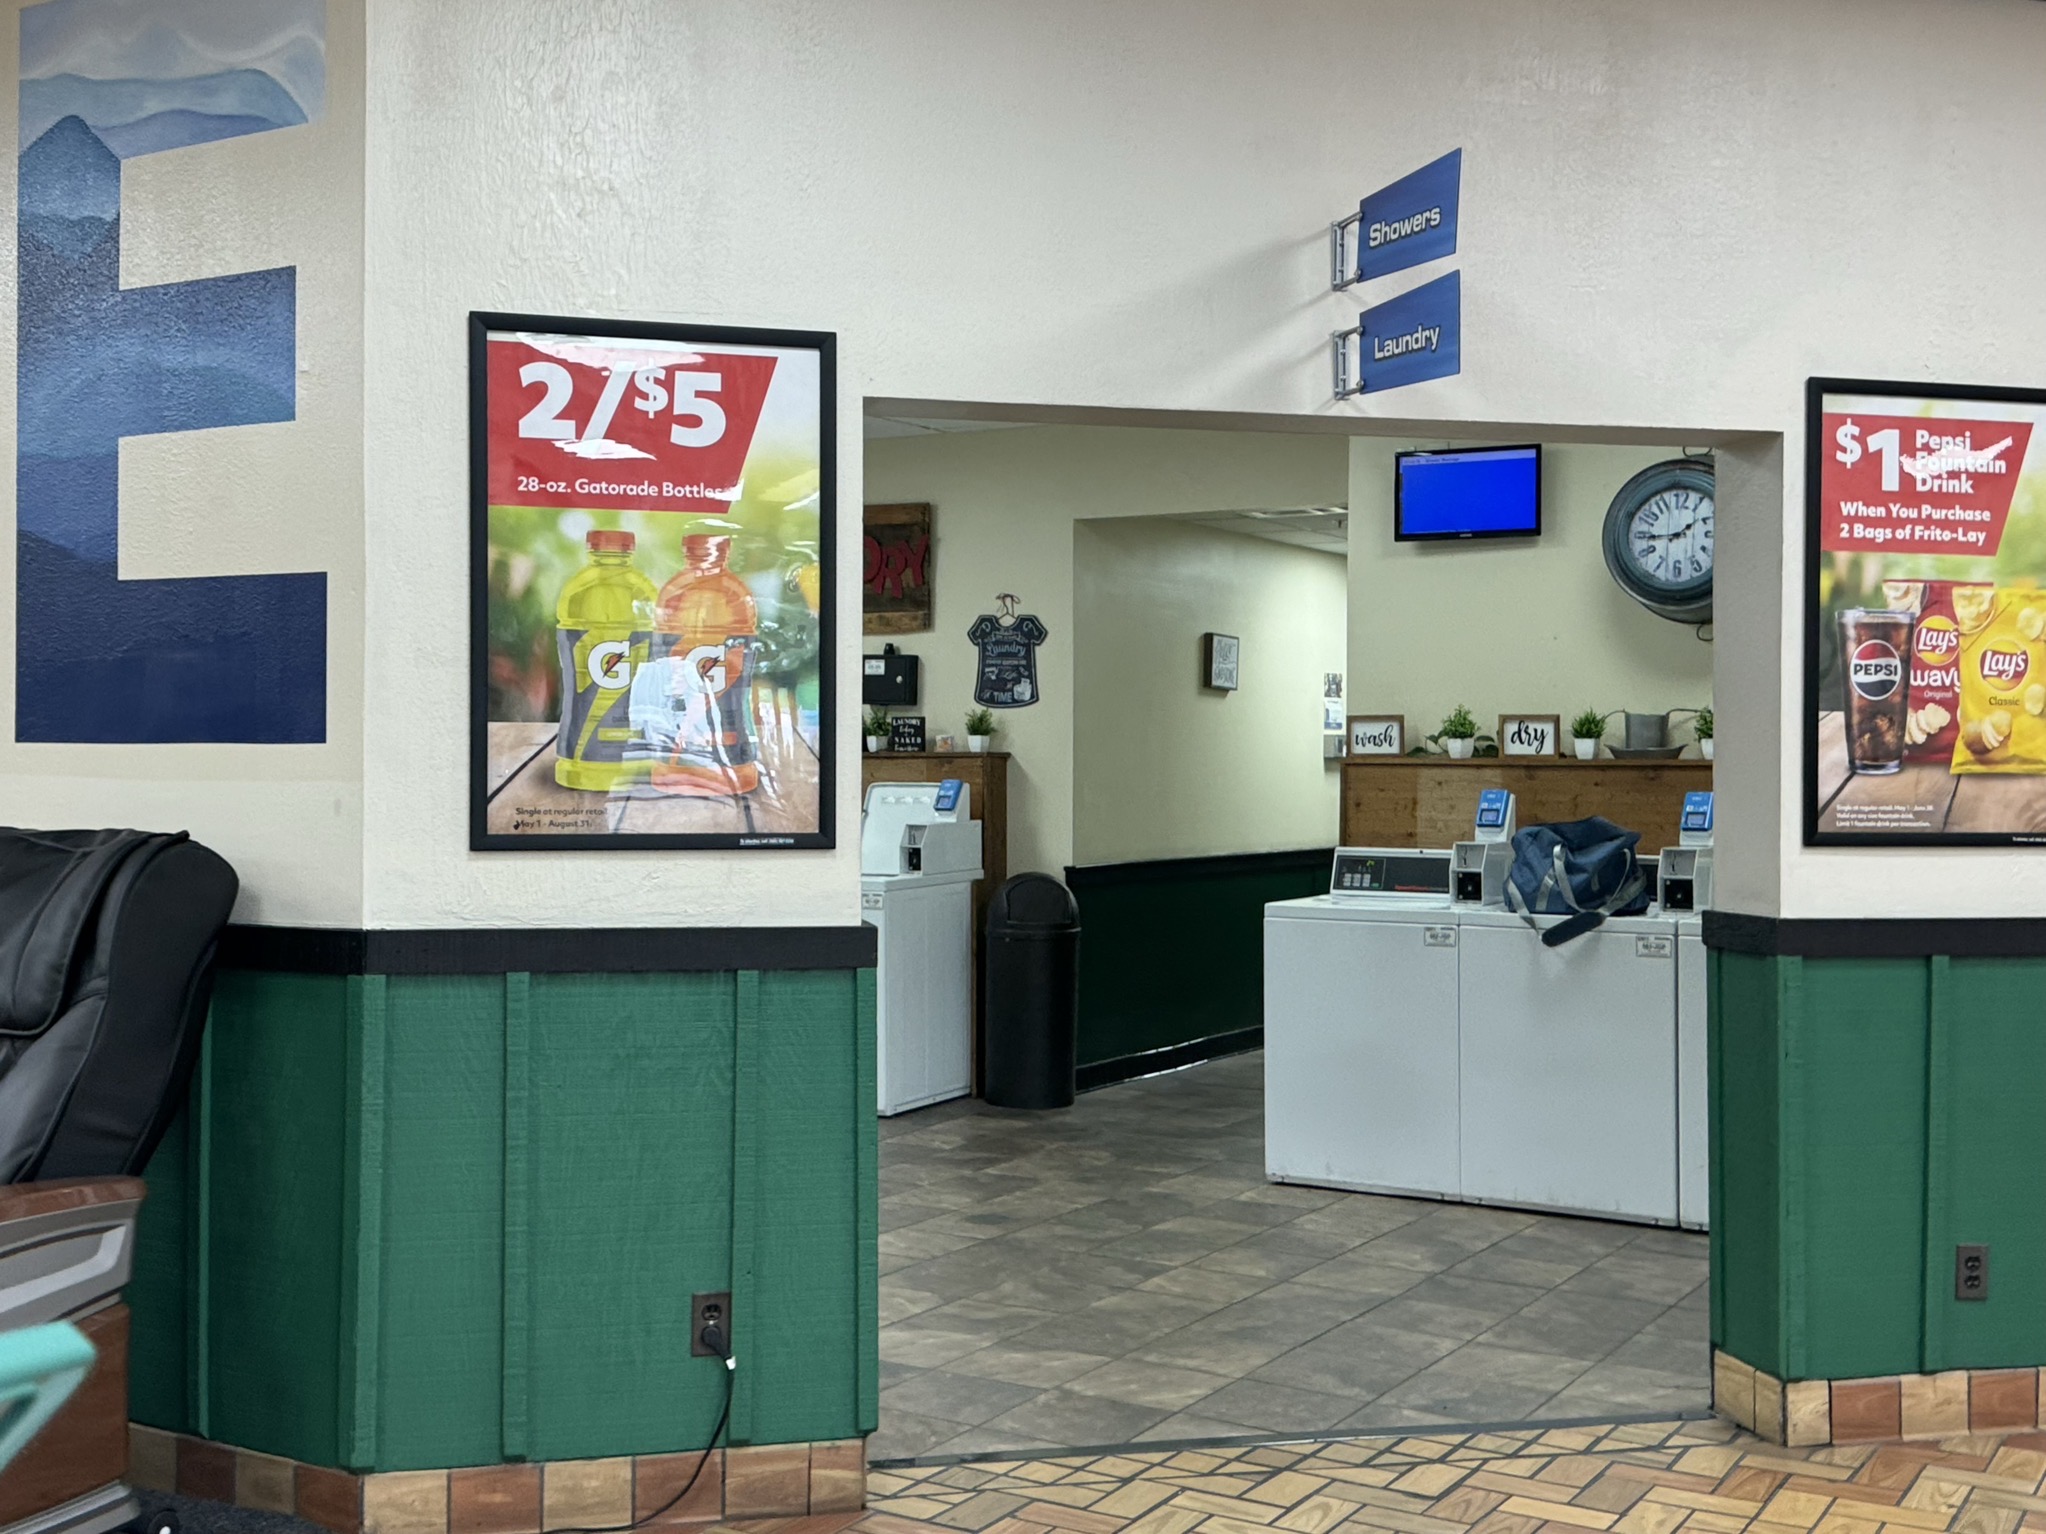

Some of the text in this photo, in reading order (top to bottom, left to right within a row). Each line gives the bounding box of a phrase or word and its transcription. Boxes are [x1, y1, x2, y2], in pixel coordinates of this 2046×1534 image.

[1369, 207, 1441, 247] Showers
[1374, 325, 1440, 360] Laundry
[1916, 430, 1971, 453] Pepsi
[1836, 418, 1900, 492] $1
[1916, 451, 2006, 474] Fountain
[517, 476, 571, 492] 28-oz.
[574, 478, 658, 497] Gatorade
[1916, 474, 1974, 494] Drink
[1673, 492, 1690, 510] 12
[1840, 501, 1991, 521] When You Purchase
[1839, 523, 1986, 546] 2 Bags of Frito-Lay
[1672, 559, 1682, 578] 6
[985, 641, 1026, 657] Laundry
[1917, 627, 1958, 655] Lay's
[588, 640, 631, 690] G
[1853, 663, 1898, 677] PEPSI
[1982, 651, 2026, 680] Lay's
[993, 691, 1013, 703] TIME
[1923, 690, 1953, 699] Original
[1988, 696, 2020, 706] Classic
[1355, 724, 1396, 748] wash
[1510, 719, 1549, 754] dry
[515, 807, 542, 817] Single
[542, 808, 552, 816] at
[553, 807, 584, 818] regular
[548, 820, 578, 829] August
